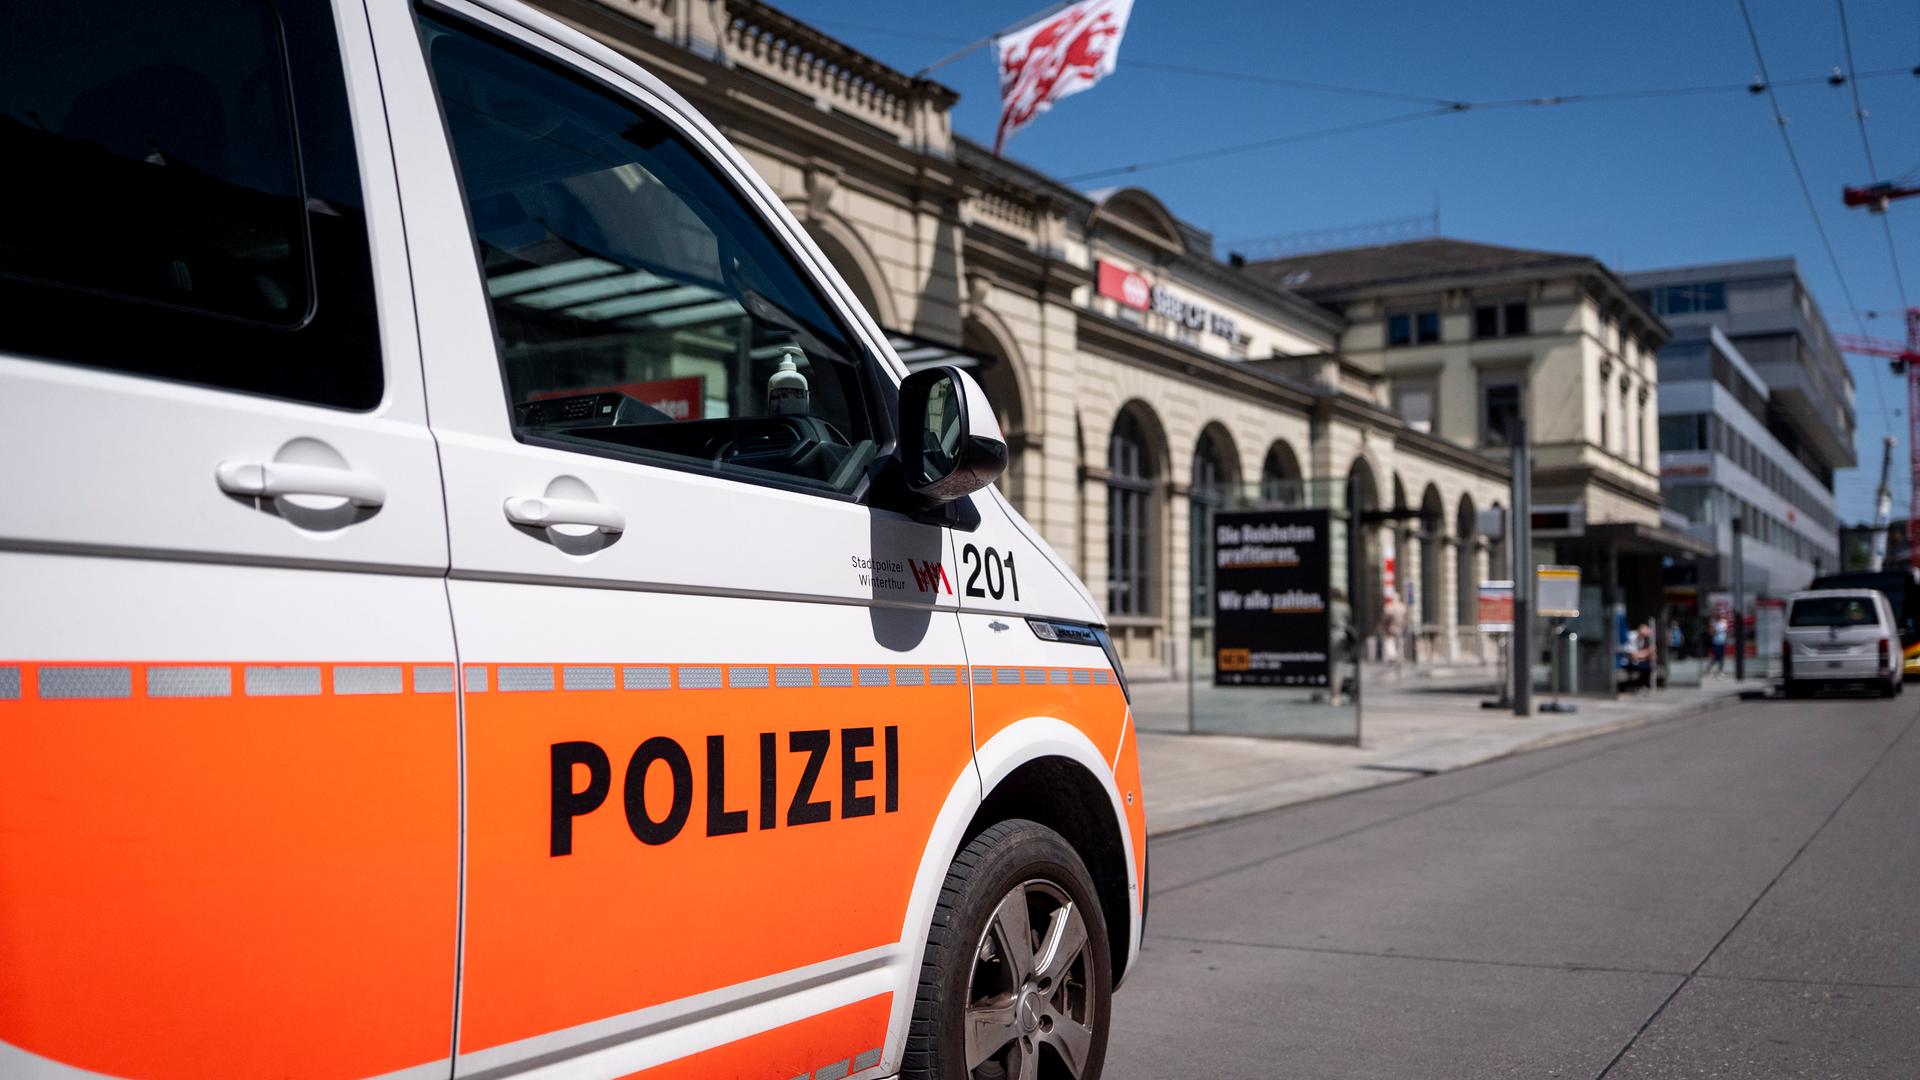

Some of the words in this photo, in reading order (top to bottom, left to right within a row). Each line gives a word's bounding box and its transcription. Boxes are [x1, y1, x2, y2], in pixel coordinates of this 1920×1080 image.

[1217, 524, 1240, 545] Die
[851, 555, 904, 574] Stadtpolizei
[963, 543, 1020, 602] 201
[858, 573, 905, 590] Winterthur
[1218, 590, 1242, 610] Wir
[1243, 589, 1271, 610] alle
[550, 725, 898, 858] POLIZEI
